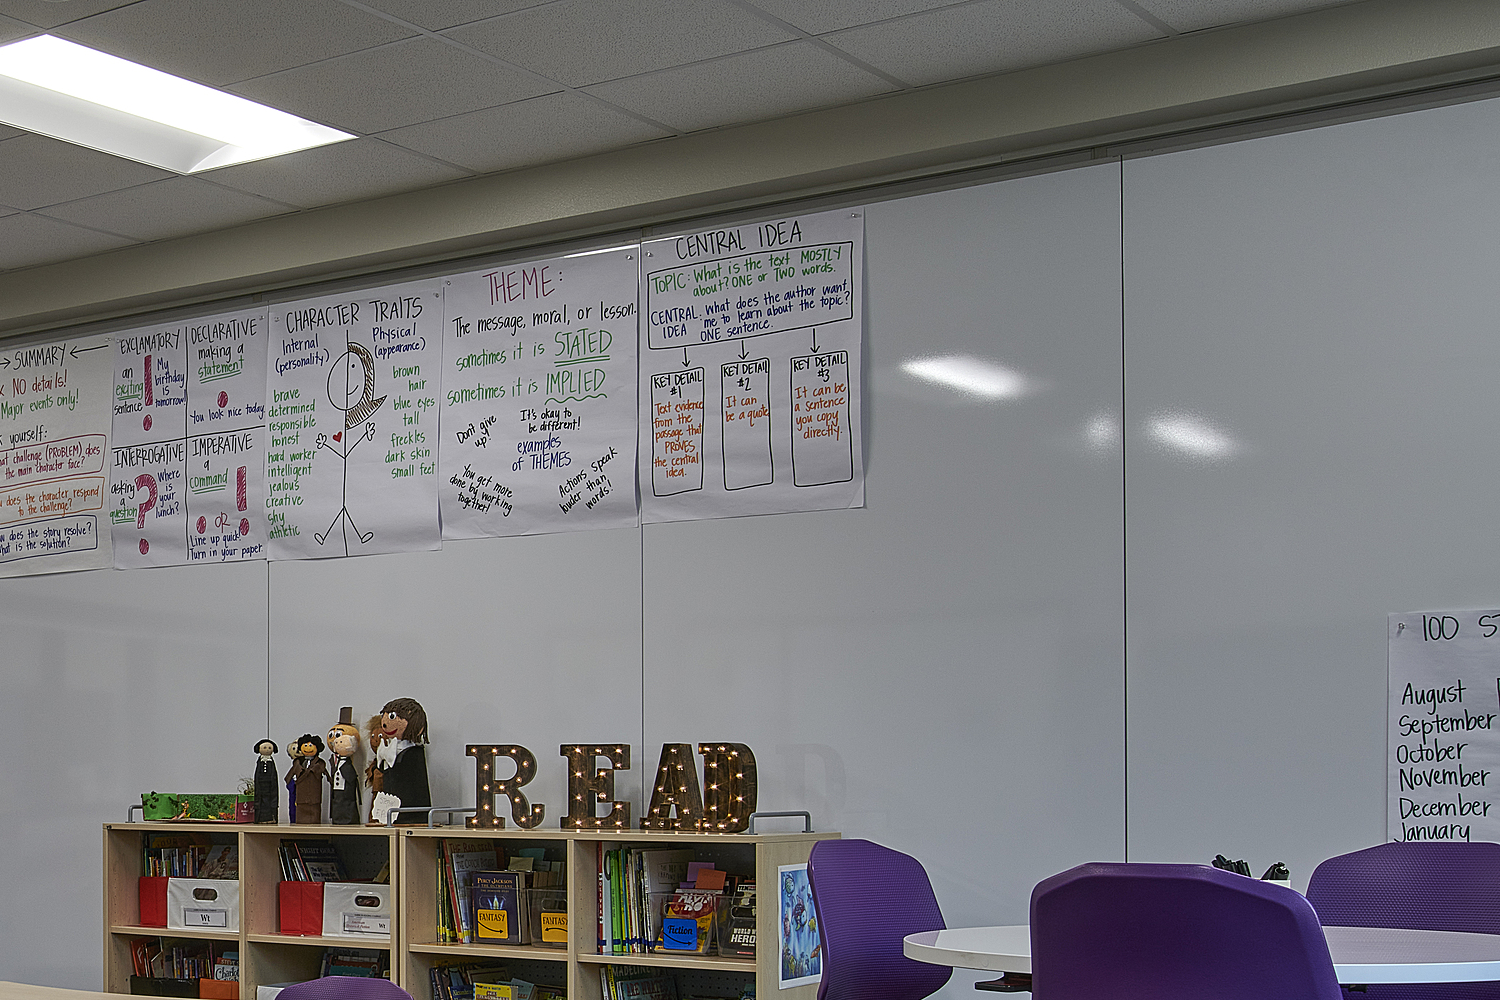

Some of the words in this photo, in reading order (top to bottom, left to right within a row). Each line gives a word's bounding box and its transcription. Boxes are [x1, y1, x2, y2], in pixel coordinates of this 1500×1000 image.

[676, 229, 746, 260] CENTRAL
[758, 220, 802, 248] IDEA
[693, 266, 722, 286] What
[728, 261, 740, 275] is
[744, 256, 762, 271] the
[768, 252, 790, 267] text
[800, 246, 842, 264] MOSTLY
[482, 266, 564, 305] THEME:
[693, 276, 730, 298] about?
[732, 274, 753, 288] ONE
[758, 272, 768, 284] or
[774, 268, 796, 282] TWO
[802, 263, 836, 276] words.
[736, 296, 759, 308] does
[764, 292, 781, 302] the
[784, 286, 816, 301] author
[822, 280, 848, 294] want
[286, 302, 360, 333] CHARACTER
[369, 297, 423, 323] TRAITS
[452, 316, 471, 337] The
[477, 315, 527, 337] message,
[533, 304, 570, 327] moral,
[578, 307, 592, 319] or
[600, 301, 637, 322] lesson.
[704, 317, 718, 329] me
[720, 312, 730, 324] to
[738, 308, 762, 322] learn
[767, 303, 794, 316] about
[800, 299, 816, 310] the
[820, 290, 850, 310] topic?
[191, 318, 257, 345] DECLARATIVE
[372, 322, 417, 343] Physical
[662, 325, 687, 339] IDEA
[700, 330, 722, 342] ONE
[726, 318, 774, 338] sentence.
[120, 329, 181, 355] EXCLAMATORY
[198, 345, 232, 362] making
[237, 343, 244, 353] a
[282, 333, 319, 355] Internal
[375, 337, 426, 358] (appearance)
[456, 349, 507, 371] sometimes
[513, 342, 523, 360] it
[534, 343, 545, 357] is
[554, 328, 612, 358] STATED
[13, 343, 66, 370] SUMMARY
[198, 358, 244, 377] statement
[275, 349, 330, 376] (personality)
[793, 358, 810, 372] KEY
[814, 352, 846, 368] DETAIL
[12, 378, 27, 398] NO
[32, 369, 67, 392] details!
[817, 368, 830, 382] #3
[274, 389, 301, 402] brave
[447, 382, 505, 406] sometimes
[512, 377, 522, 397] it
[528, 380, 538, 393] is
[546, 368, 605, 395] IMPLIED
[1, 401, 24, 421] Major
[29, 398, 53, 413] events
[56, 389, 79, 410] only!
[190, 411, 205, 424] You
[209, 408, 224, 421] look
[228, 408, 242, 418] nice
[268, 399, 316, 417] determined
[269, 416, 316, 434] responsible
[403, 413, 419, 426] tall
[192, 434, 253, 457] IMPERATIVE
[271, 432, 300, 447] honest
[391, 431, 426, 448] freckles
[517, 435, 561, 455] examples
[114, 443, 184, 468] INTERROGATIVE
[512, 457, 524, 472] of
[530, 451, 572, 470] THEMES
[190, 468, 229, 489] command
[267, 463, 313, 482] intelligent
[266, 494, 304, 508] creative
[1422, 614, 1459, 641] 100
[1478, 614, 1500, 638] S
[1401, 679, 1466, 715] August
[1399, 709, 1497, 744] September
[1397, 738, 1468, 764] October
[465, 742, 758, 833] READ
[1400, 764, 1491, 791] November
[1399, 793, 1491, 819] December
[1394, 822, 1471, 843] January
[200, 914, 210, 922] Wt
[479, 913, 505, 921] FANTASY
[667, 925, 693, 935] Fiction
